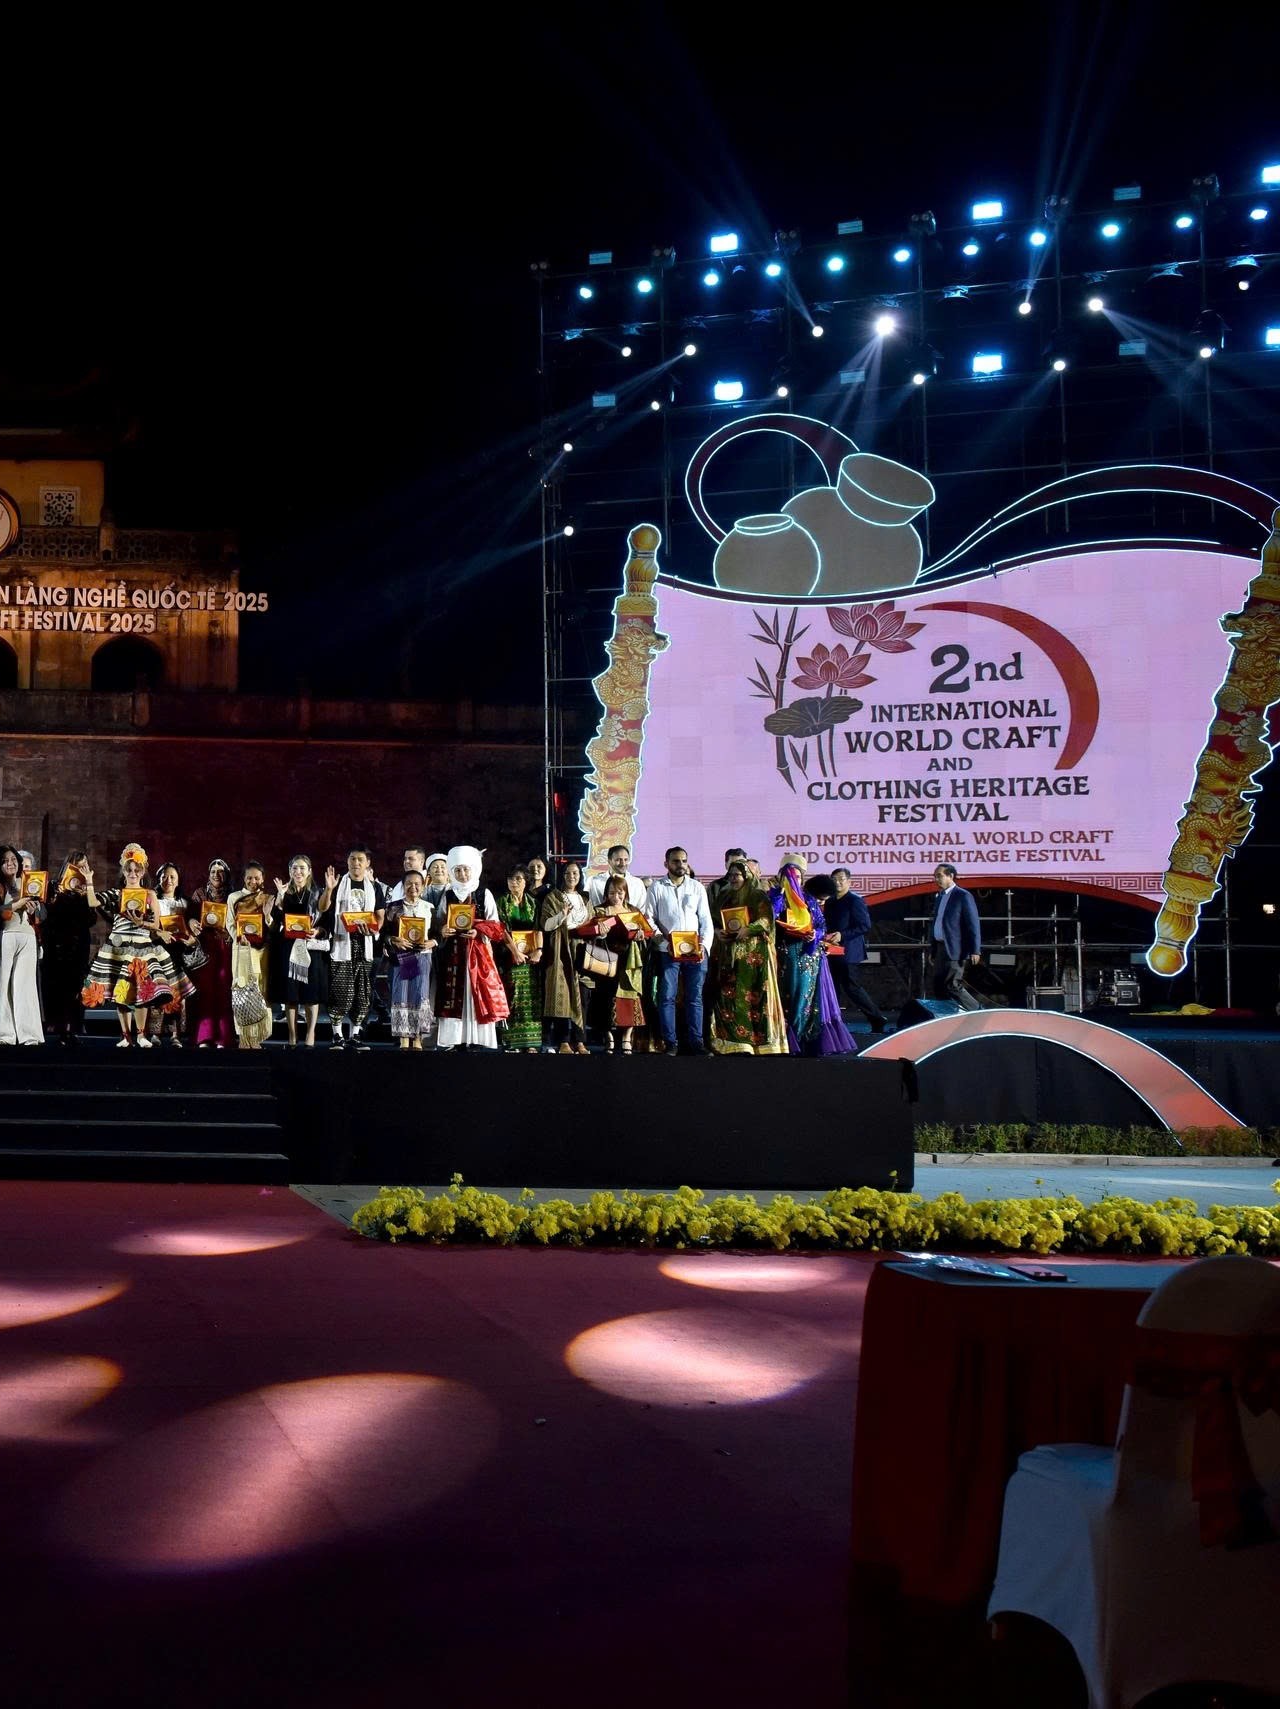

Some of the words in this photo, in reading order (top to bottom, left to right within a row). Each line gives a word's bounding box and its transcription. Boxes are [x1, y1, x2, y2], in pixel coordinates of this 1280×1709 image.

[16, 580, 68, 606] LÀNG
[73, 580, 126, 608] NGHỀ
[131, 581, 191, 609] QUỐC
[197, 585, 217, 610] TẾ
[223, 592, 269, 612] 2025
[24, 610, 105, 631] FESTIVAL
[110, 613, 156, 633] 2025
[928, 644, 1024, 693] 2nd
[870, 699, 1057, 723] INTERNATIONAL
[844, 728, 953, 753] WORLD
[962, 725, 1061, 750] CRAFT
[927, 757, 973, 772] AND
[807, 778, 941, 801] CLOTHING
[950, 775, 1090, 798] HERITAGE
[877, 802, 1009, 823] FESTIVAL
[774, 834, 812, 847] 2ND
[816, 832, 965, 846] INTERNATIONAL
[973, 831, 1044, 845] WORLD
[1049, 830, 1113, 844] CRAFT
[824, 851, 915, 864] CLOTHING
[920, 850, 1010, 863] HERITAGE
[1015, 849, 1105, 862] FESTIVAL
